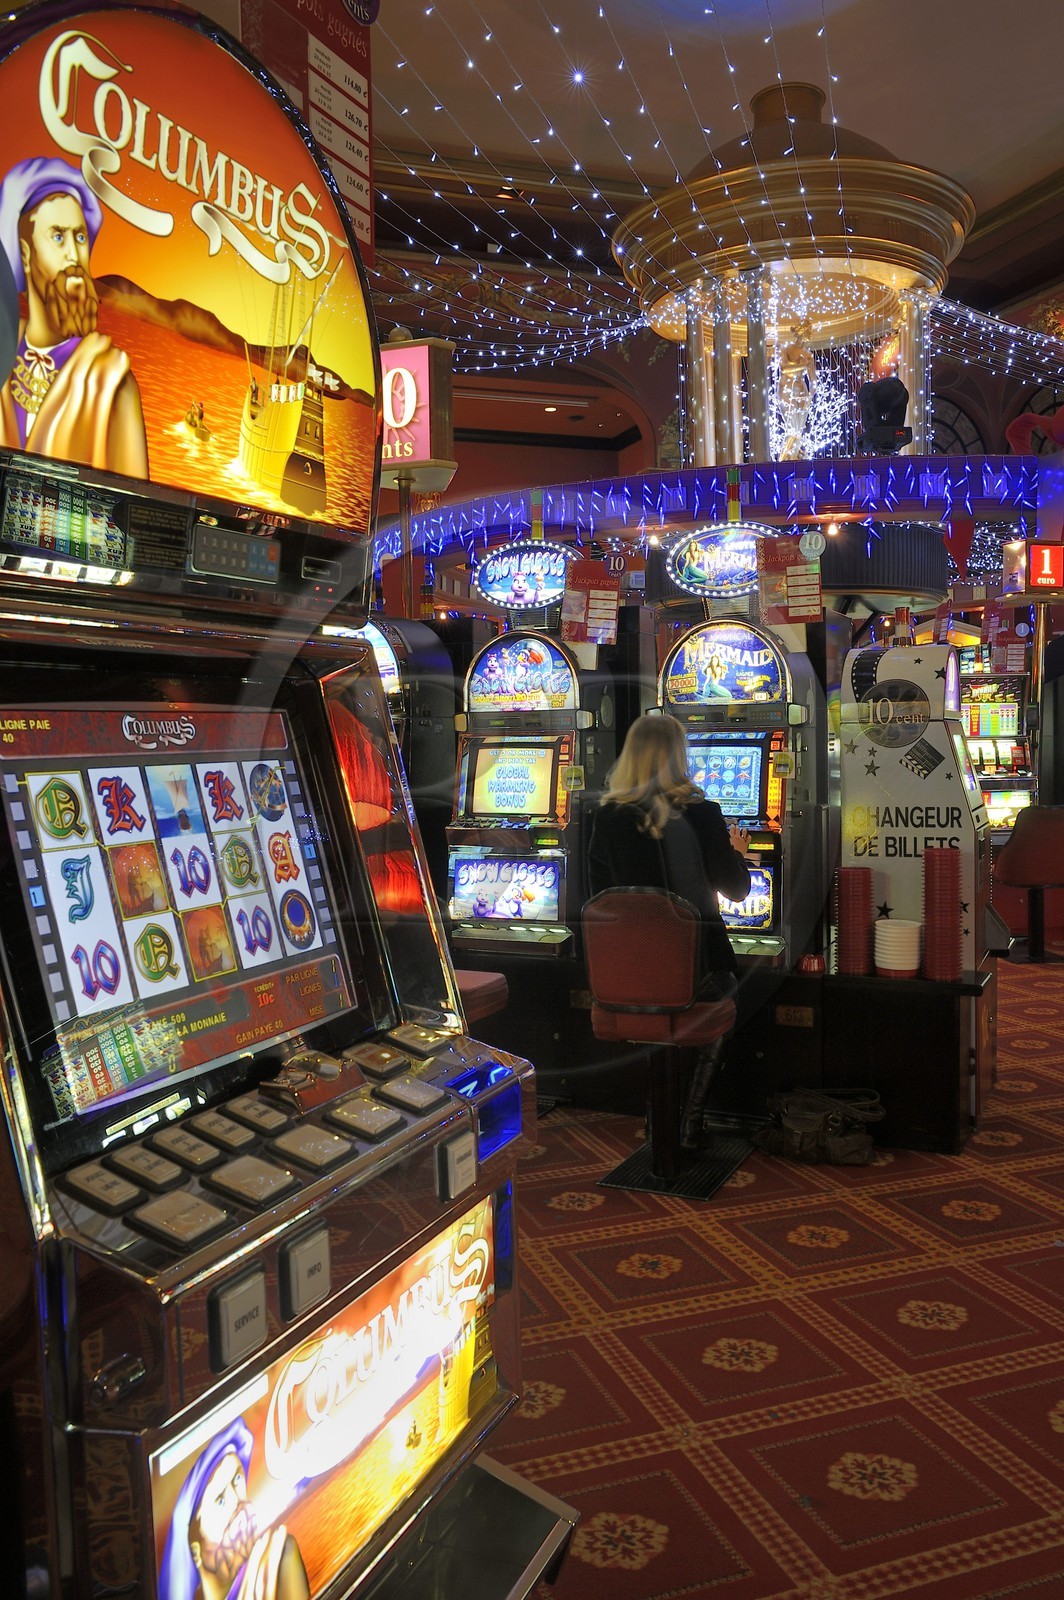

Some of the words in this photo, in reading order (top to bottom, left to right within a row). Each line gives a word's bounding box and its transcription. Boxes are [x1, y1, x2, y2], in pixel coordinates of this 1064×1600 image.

[327, 12, 367, 58] gagnés
[344, 74, 362, 94] 114.80
[345, 109, 363, 128] 126.70
[39, 30, 332, 285] COLUMBUS
[345, 140, 363, 159] 124.40
[346, 175, 364, 193] 124.60
[804, 534, 822, 550] 10
[609, 556, 625, 571] 10
[767, 554, 795, 563] Jackpots
[1041, 548, 1053, 574] 1
[574, 576, 599, 586] Jackpots
[1037, 577, 1056, 585] euro
[683, 637, 774, 669] MERMAID
[867, 697, 894, 725] 10
[895, 713, 925, 724] cent
[0, 719, 27, 731] LIGNE
[29, 719, 51, 730] PAIE
[121, 714, 196, 750] COLUMBUS
[2, 733, 15, 744] 40
[496, 766, 530, 780] GLOBAL
[488, 781, 536, 794] WARMING
[495, 794, 526, 808] BONUS
[852, 806, 962, 829] CHANGEUR
[853, 835, 879, 857] DE
[885, 836, 961, 858] BILLETS
[170, 845, 211, 898] 10
[458, 861, 499, 886] SNOW
[236, 905, 274, 956] 10
[71, 939, 122, 1001] 10
[285, 974, 300, 985] PAR
[300, 967, 319, 981] LIGNE
[299, 982, 322, 997] LIGNES
[170, 1012, 187, 1025] 509
[309, 1004, 324, 1018] MISE
[190, 1012, 227, 1033] MONNAIE
[235, 1030, 254, 1045] GAIN
[307, 1261, 323, 1279] INFO
[234, 1306, 260, 1333] SERVICE
